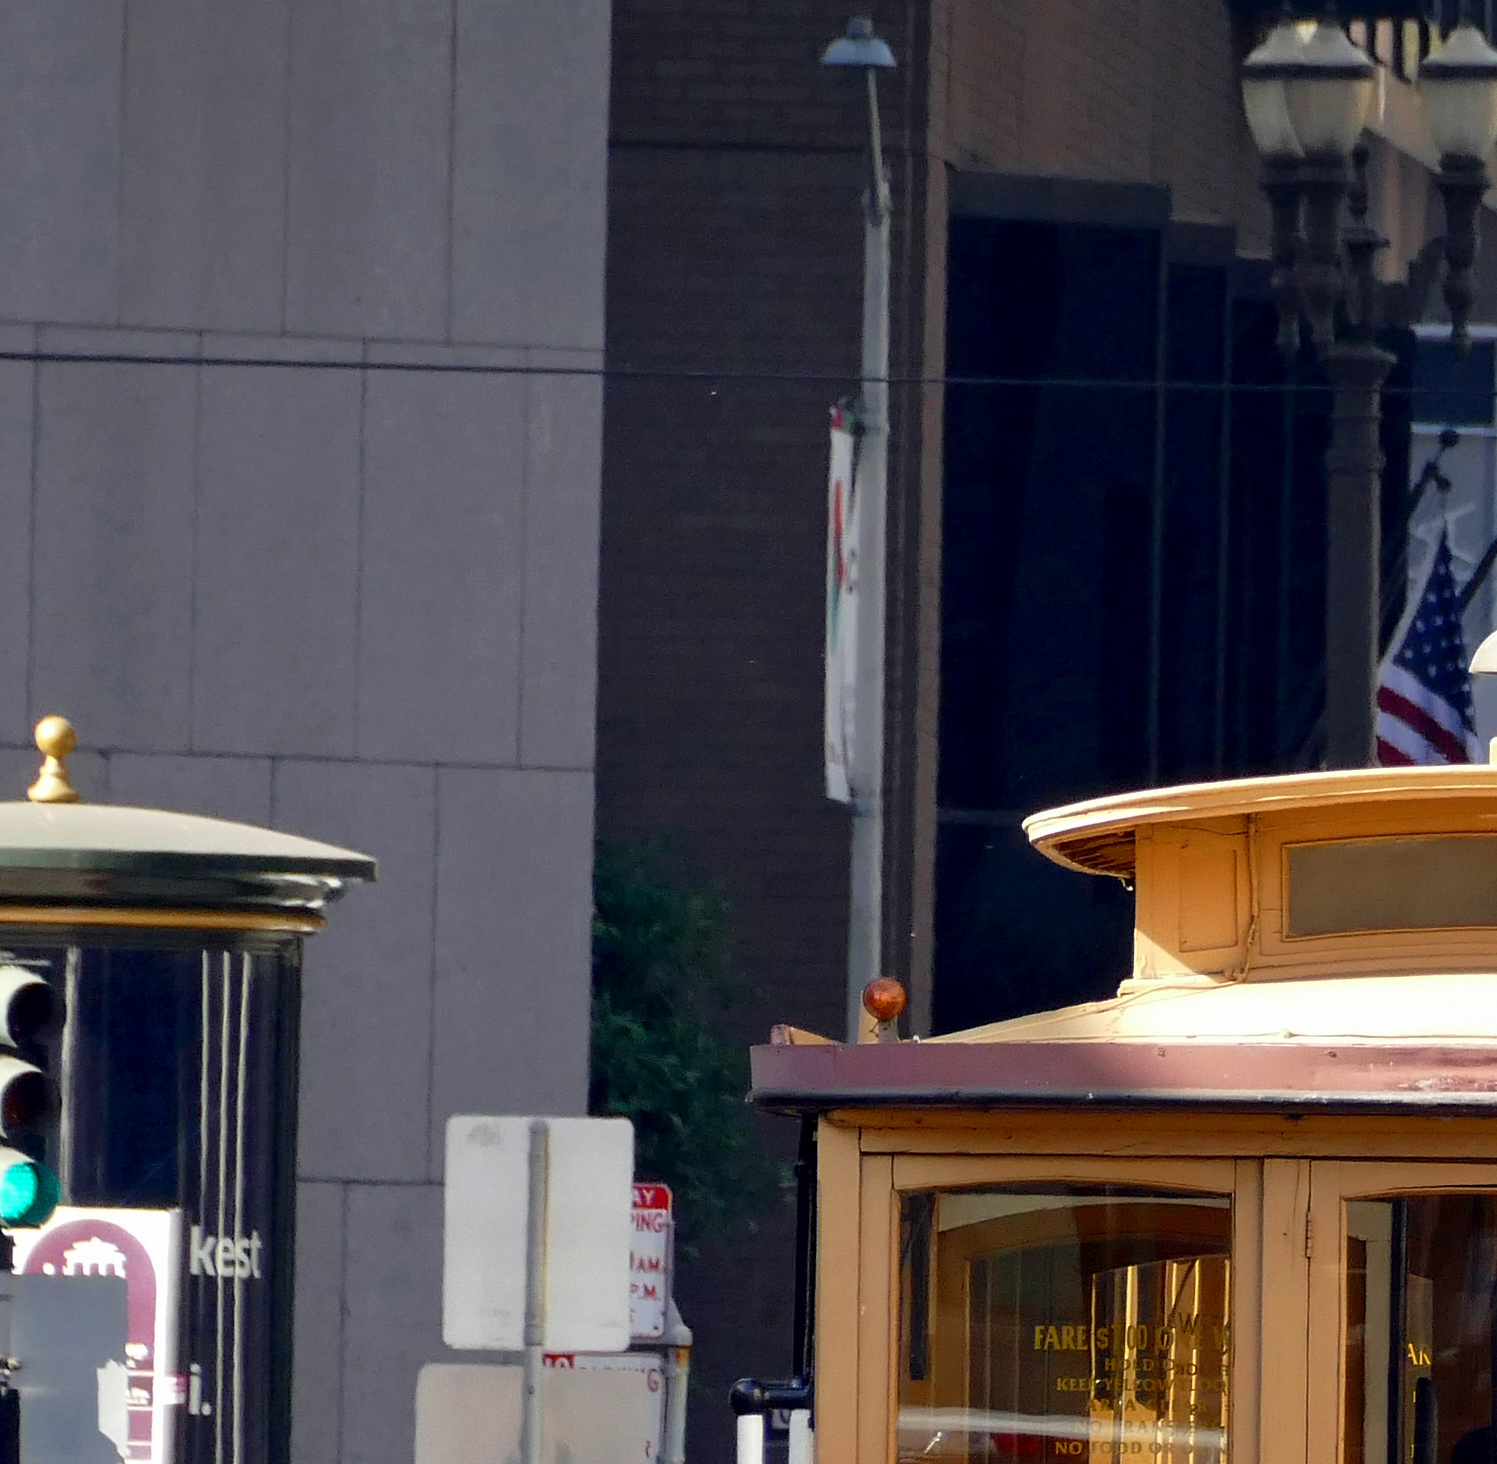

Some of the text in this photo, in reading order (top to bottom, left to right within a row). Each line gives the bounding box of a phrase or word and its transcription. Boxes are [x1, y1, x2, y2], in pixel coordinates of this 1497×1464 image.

[189, 1225, 262, 1280] kest
[1034, 1324, 1088, 1351] FARE
[1054, 1441, 1083, 1456] NO
